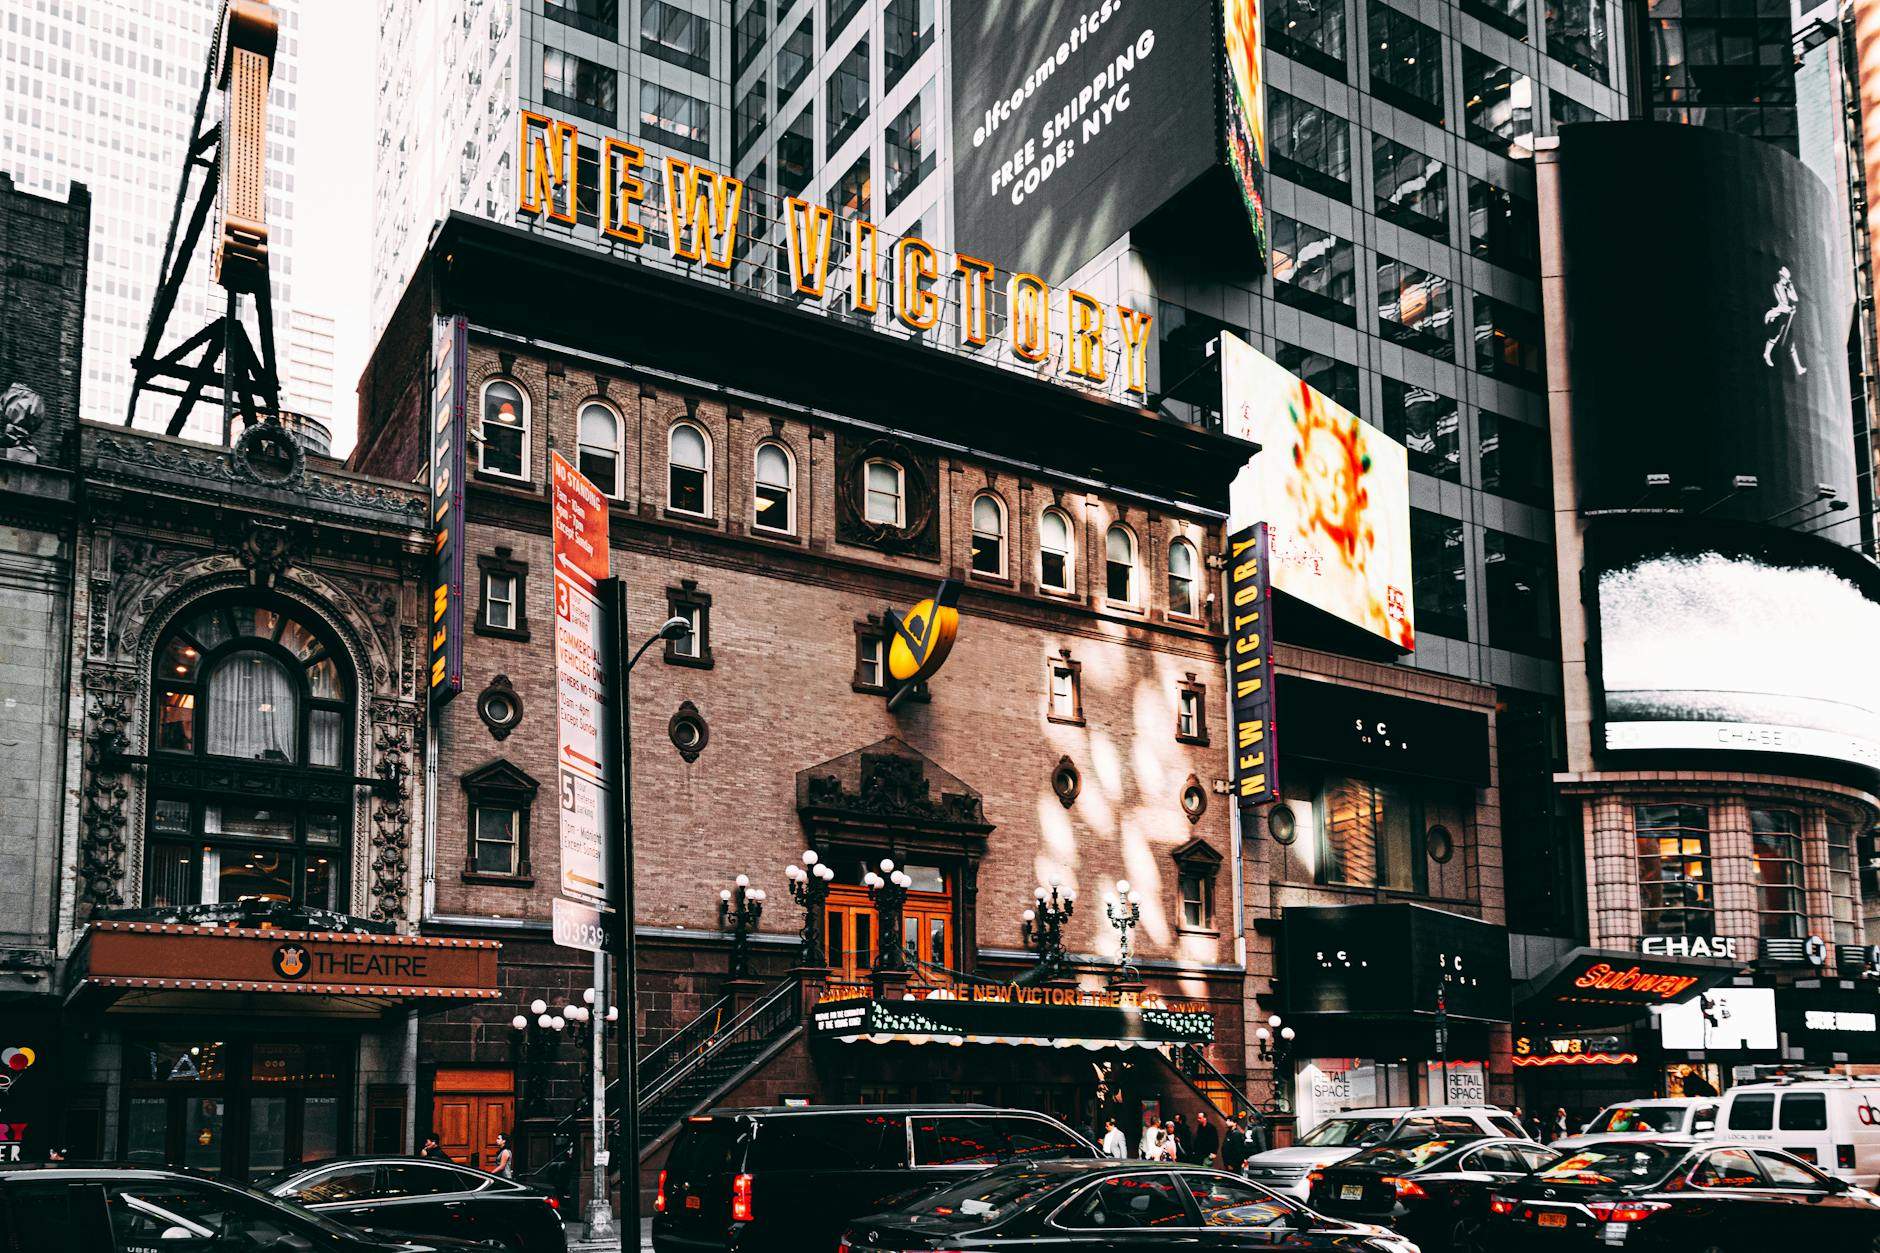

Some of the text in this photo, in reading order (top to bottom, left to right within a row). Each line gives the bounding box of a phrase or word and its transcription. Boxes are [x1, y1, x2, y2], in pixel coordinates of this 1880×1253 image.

[991, 29, 1155, 196] FREE SHIPPING
[1011, 83, 1131, 205] CODE: NYC
[518, 110, 1152, 394] NEW VICTORY
[555, 461, 600, 511] NO STANDING
[556, 516, 593, 557] Except Sunday
[558, 582, 568, 617] 3
[432, 583, 448, 689] NEW
[1233, 537, 1265, 797] NEW VICTORY
[562, 774, 574, 809] 5
[314, 951, 427, 977] THEATRE
[1642, 935, 1737, 958] CHASE
[934, 983, 969, 1001] THE
[973, 984, 1013, 1003] NEW
[1014, 985, 1083, 1007] VICTORY
[1575, 963, 1698, 999] Subway
[1314, 1085, 1350, 1098] SPACE
[1450, 1074, 1482, 1087] RETAIL
[1450, 1087, 1483, 1100] SPACE
